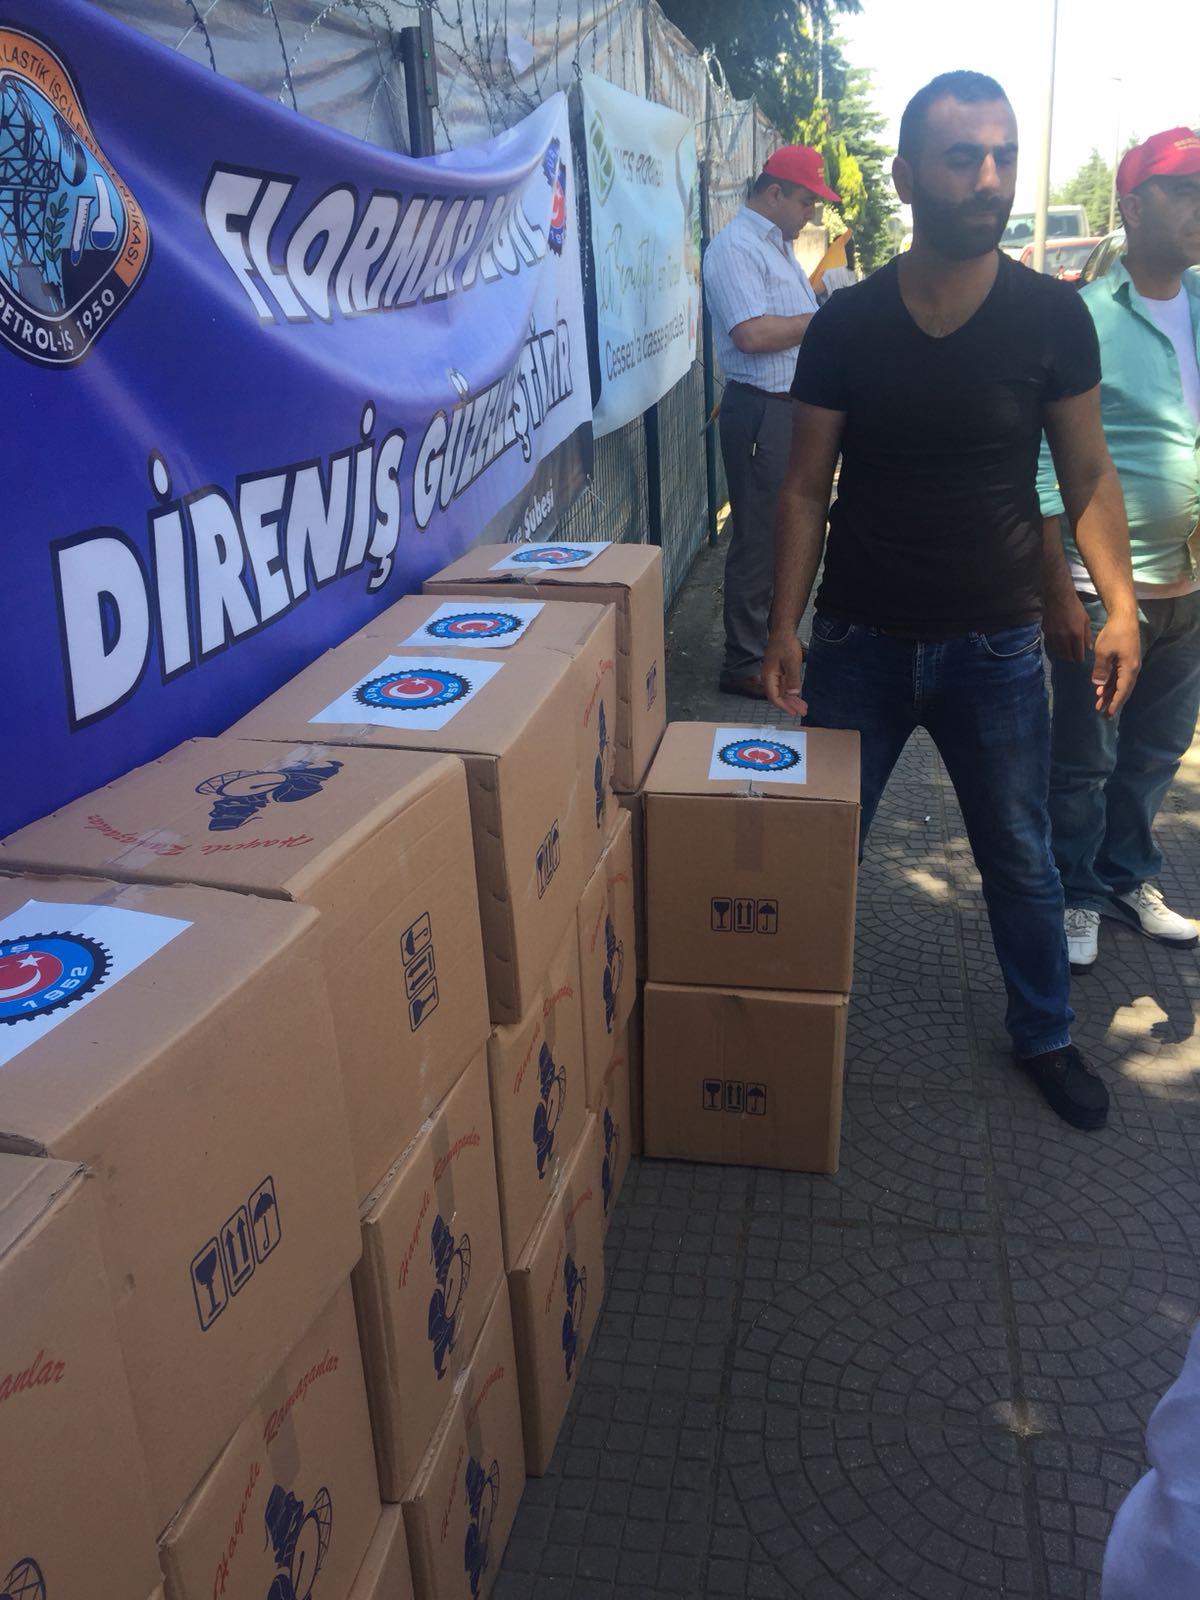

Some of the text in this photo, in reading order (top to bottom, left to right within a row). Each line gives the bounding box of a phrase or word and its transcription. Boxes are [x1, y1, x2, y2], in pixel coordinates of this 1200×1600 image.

[203, 160, 487, 325] FLORMAR
[76, 289, 115, 339] 1950
[606, 339, 635, 381] Cessez
[52, 402, 405, 731] DİRENİŞ
[22, 966, 88, 1009] 1952
